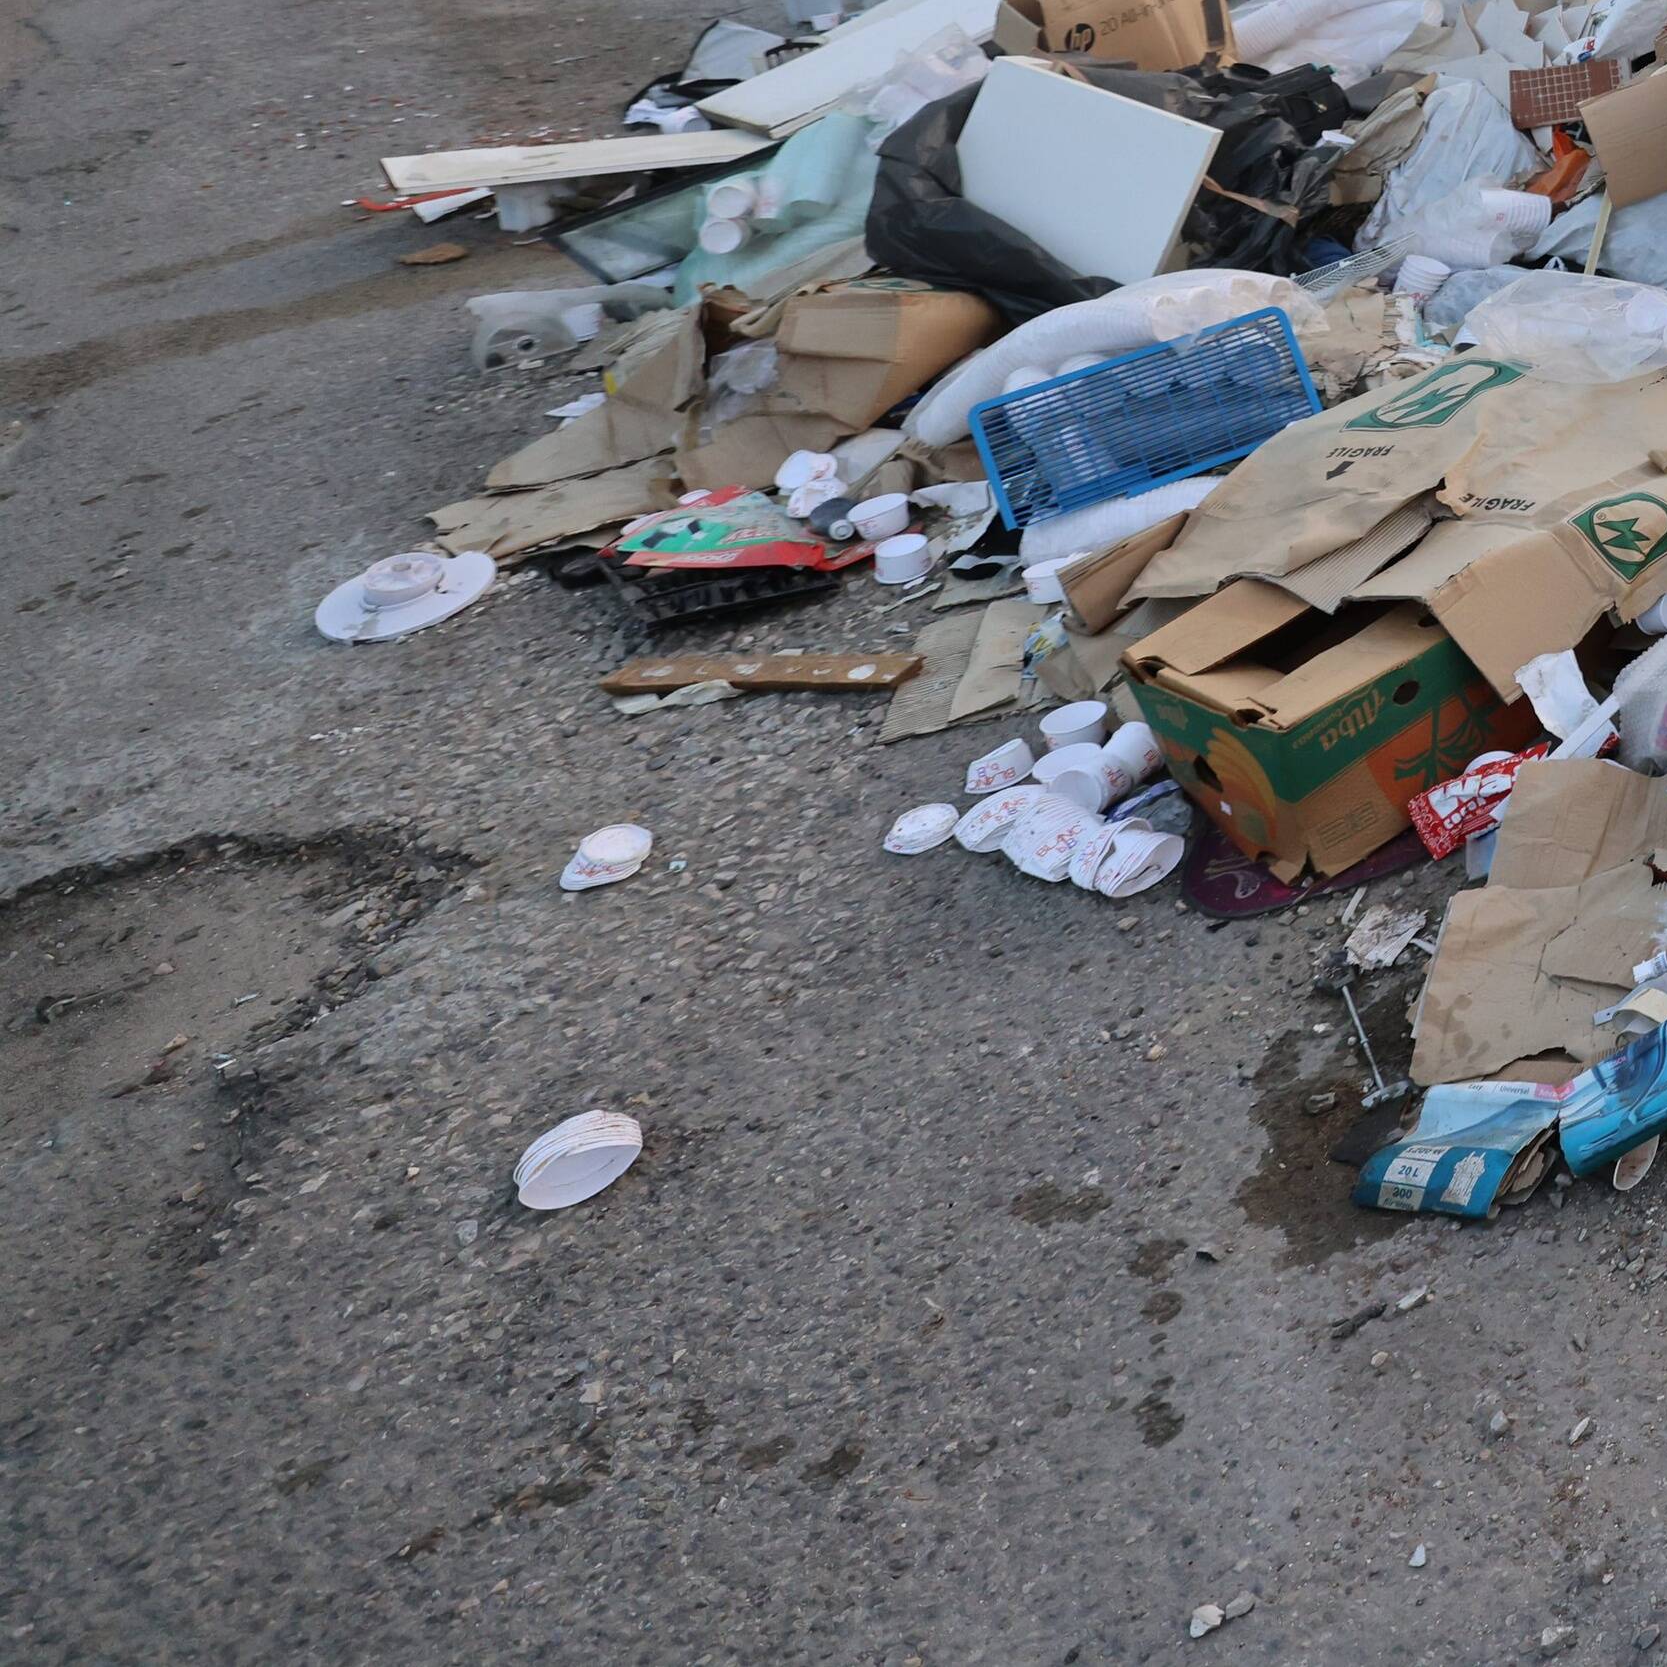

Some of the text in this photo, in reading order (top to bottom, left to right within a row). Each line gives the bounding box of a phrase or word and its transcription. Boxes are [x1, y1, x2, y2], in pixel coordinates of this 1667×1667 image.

[1327, 444, 1396, 459] FRAGILE
[1458, 492, 1536, 512] FRAGILE
[1398, 1165, 1413, 1177] 20
